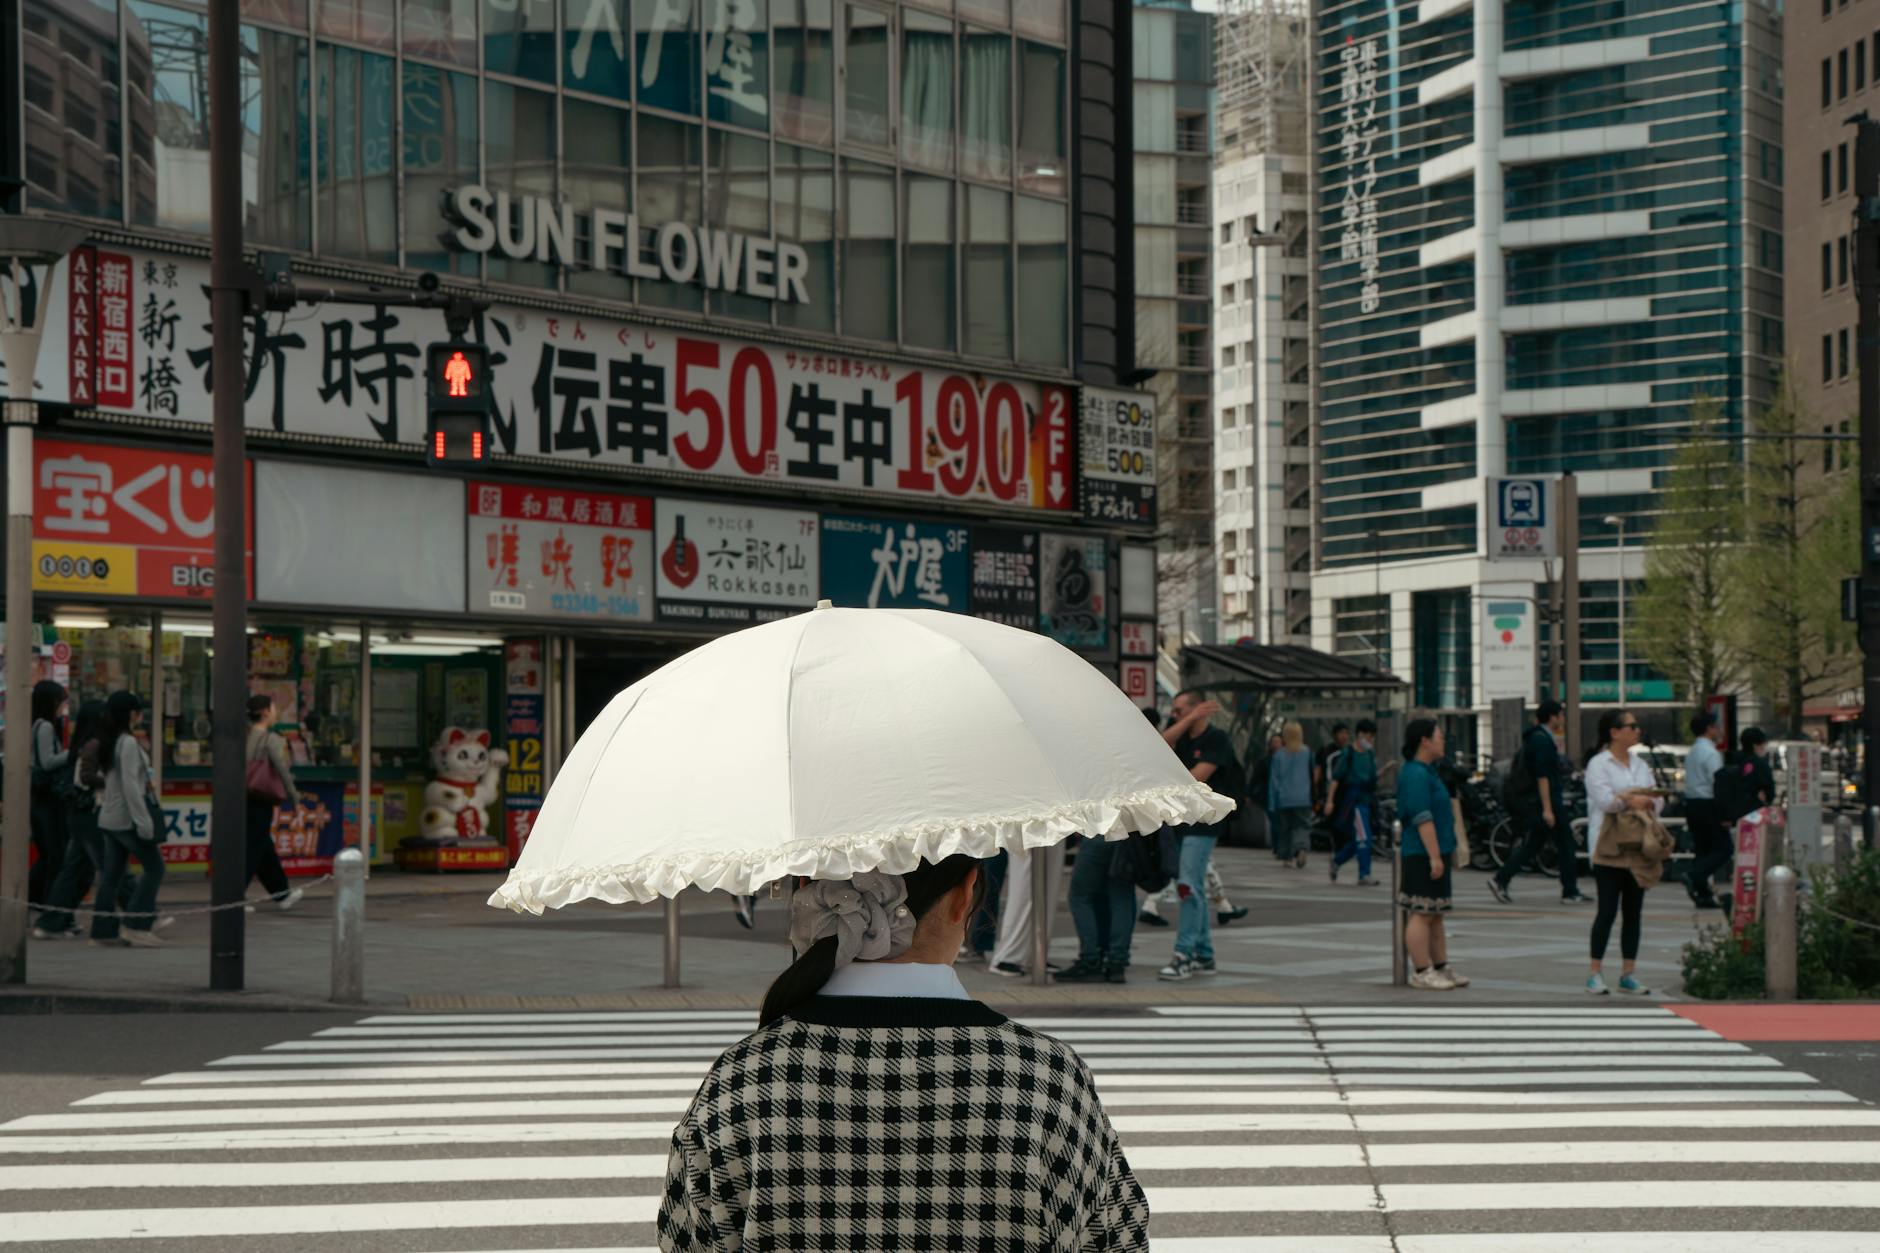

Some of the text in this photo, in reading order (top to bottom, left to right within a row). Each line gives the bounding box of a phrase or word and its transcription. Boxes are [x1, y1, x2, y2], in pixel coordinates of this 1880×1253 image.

[456, 184, 809, 304] SUN FLOWER
[142, 260, 179, 289] 東京
[74, 254, 89, 399] AKAKARA
[102, 261, 128, 394] 新宿西口
[140, 292, 182, 417] 新橋
[532, 341, 669, 464] 伝串
[1049, 391, 1065, 465] 2F
[786, 381, 893, 487] 生中
[40, 454, 215, 538] 宝くじ
[521, 493, 638, 528] 和風居酒屋
[1087, 493, 1139, 520] すみれ
[798, 519, 816, 537] 7F
[946, 529, 969, 552] 3F
[39, 553, 109, 580] toto
[707, 538, 806, 576] 六歌仙
[868, 523, 950, 608] 大戸屋
[708, 574, 810, 598] Rokkasen
[507, 738, 542, 770] 12
